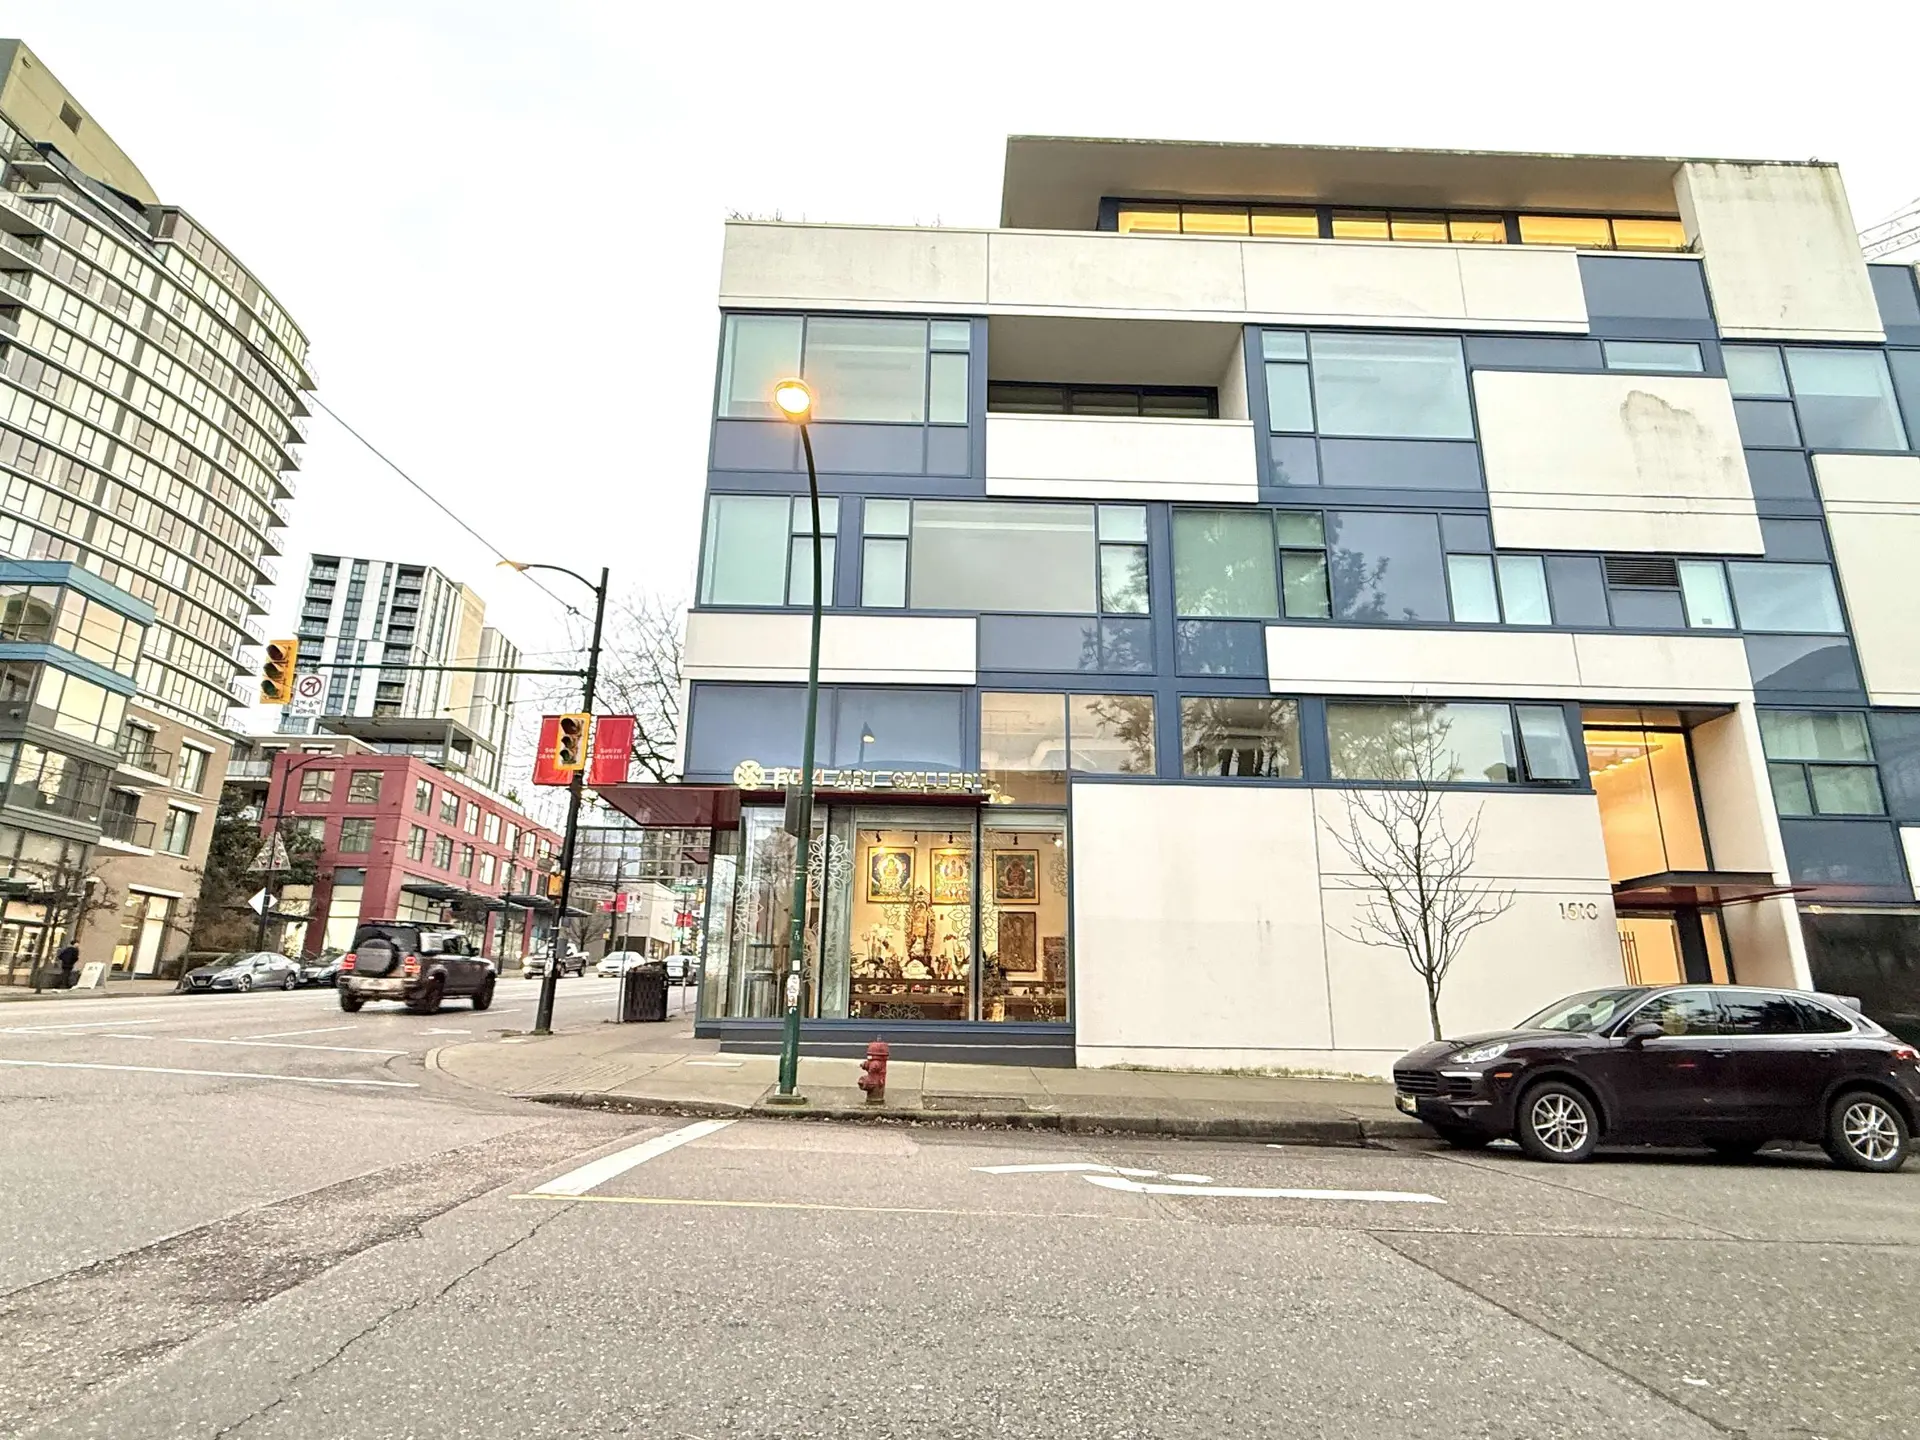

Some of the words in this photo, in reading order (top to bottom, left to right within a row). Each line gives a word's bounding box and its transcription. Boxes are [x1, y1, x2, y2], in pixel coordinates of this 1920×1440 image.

[834, 769, 875, 787] ART
[892, 771, 988, 788] GALLERY
[1558, 902, 1599, 920] 1510
